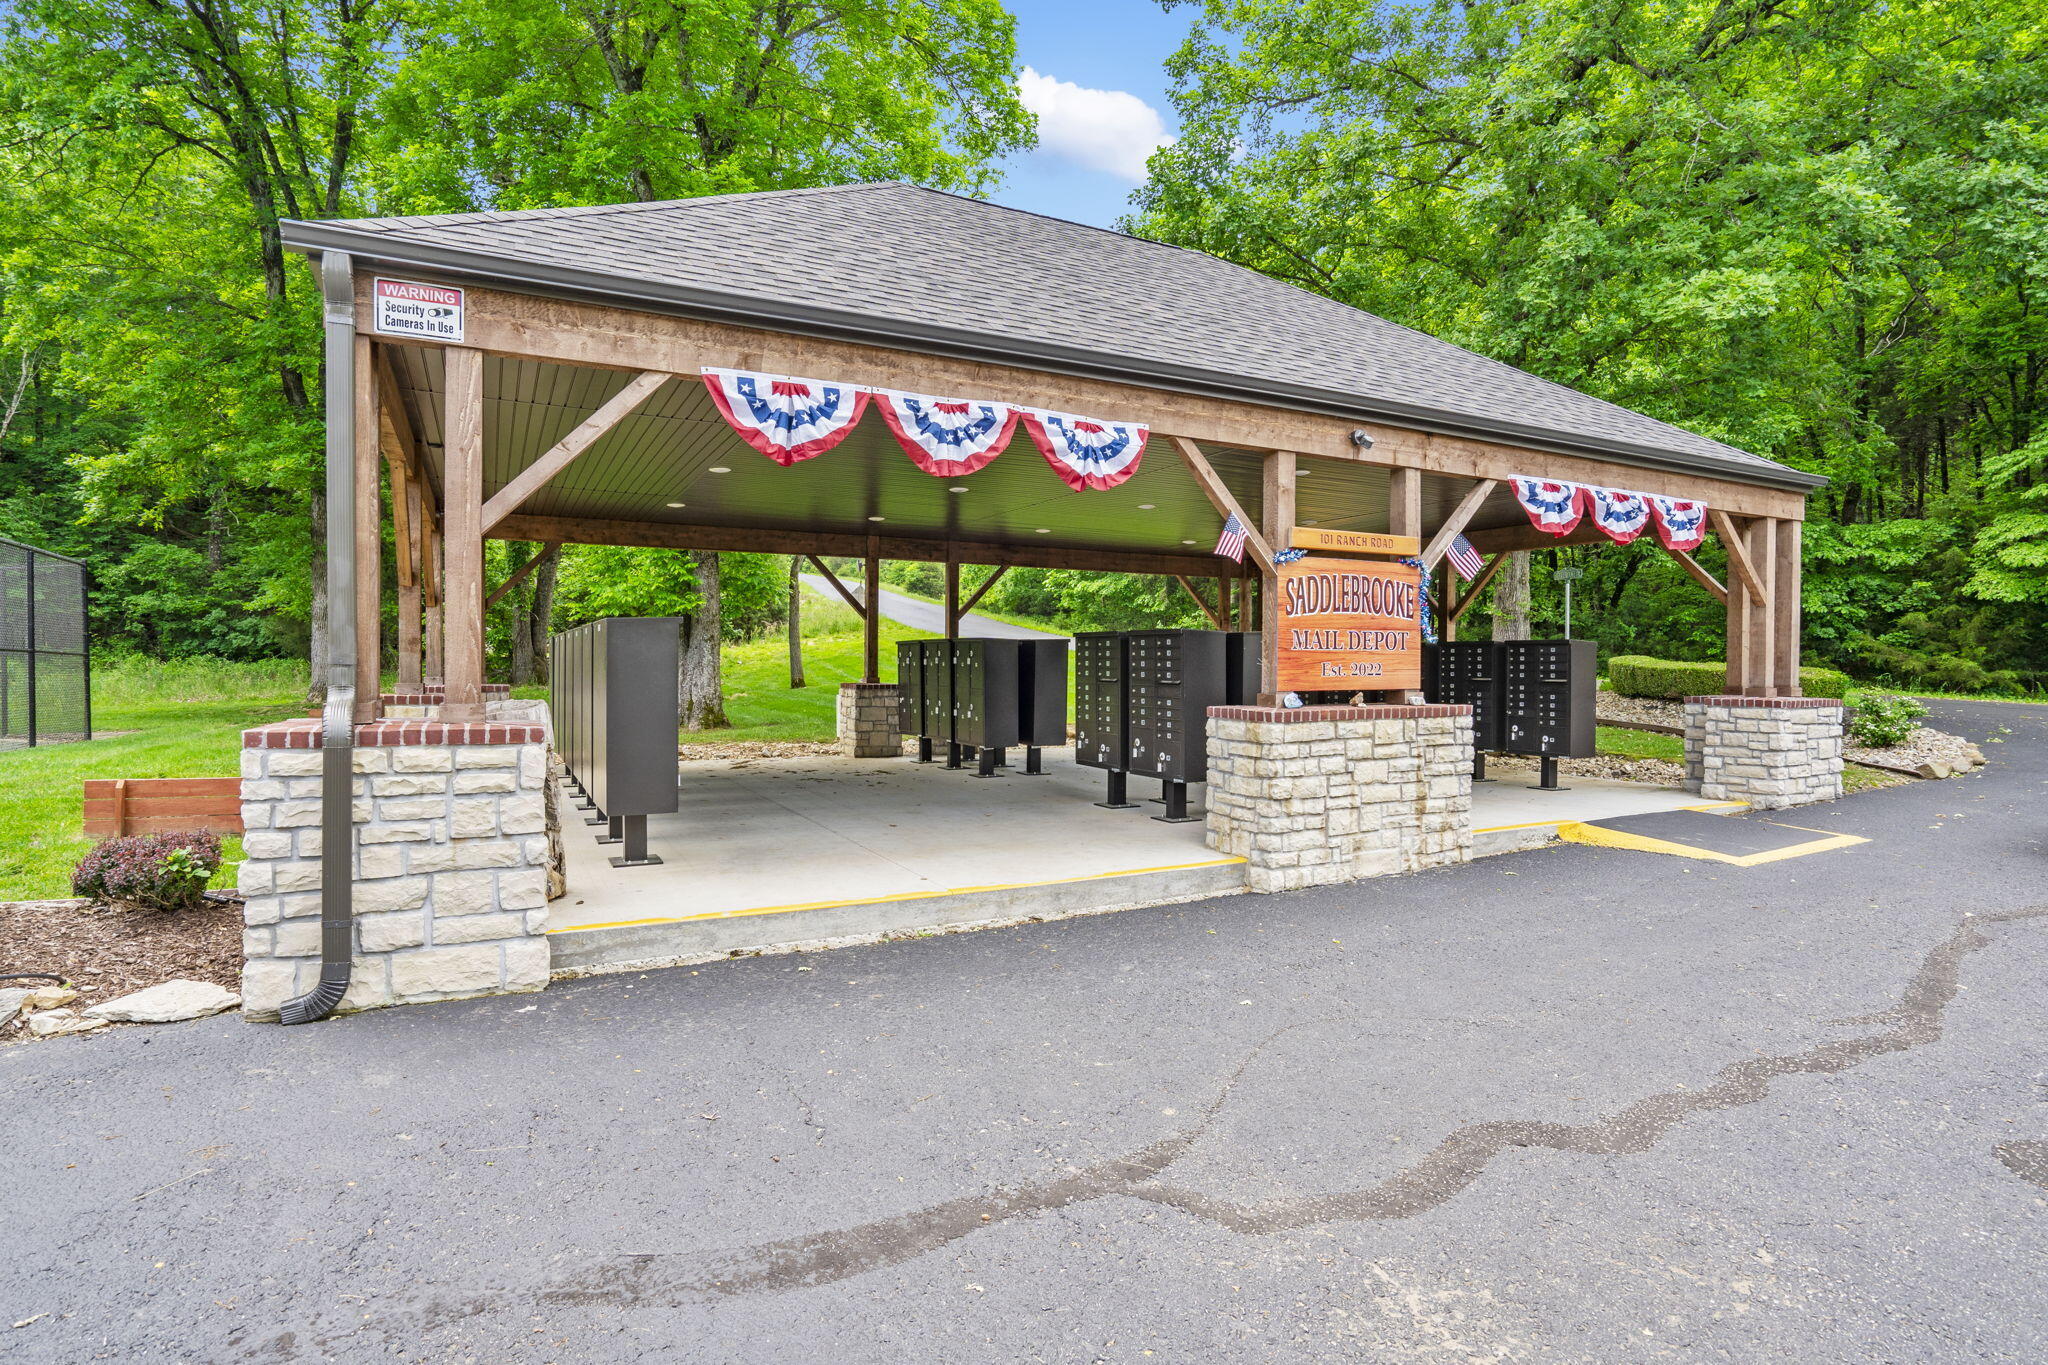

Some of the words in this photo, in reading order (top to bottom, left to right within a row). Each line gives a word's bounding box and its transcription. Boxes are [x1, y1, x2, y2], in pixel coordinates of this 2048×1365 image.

[384, 284, 456, 303] WARNING
[385, 300, 425, 318] Security
[385, 314, 424, 330] Cameras
[427, 320, 435, 331] In
[438, 321, 454, 334] Use
[1336, 535, 1368, 547] RANCH
[1371, 537, 1394, 549] ROAD
[1285, 573, 1415, 621] SADDLEBROOKE
[1292, 629, 1344, 651] MAIL
[1348, 630, 1409, 651] DEPOT
[1321, 662, 1346, 677] Est.
[1350, 662, 1382, 677] 2022
